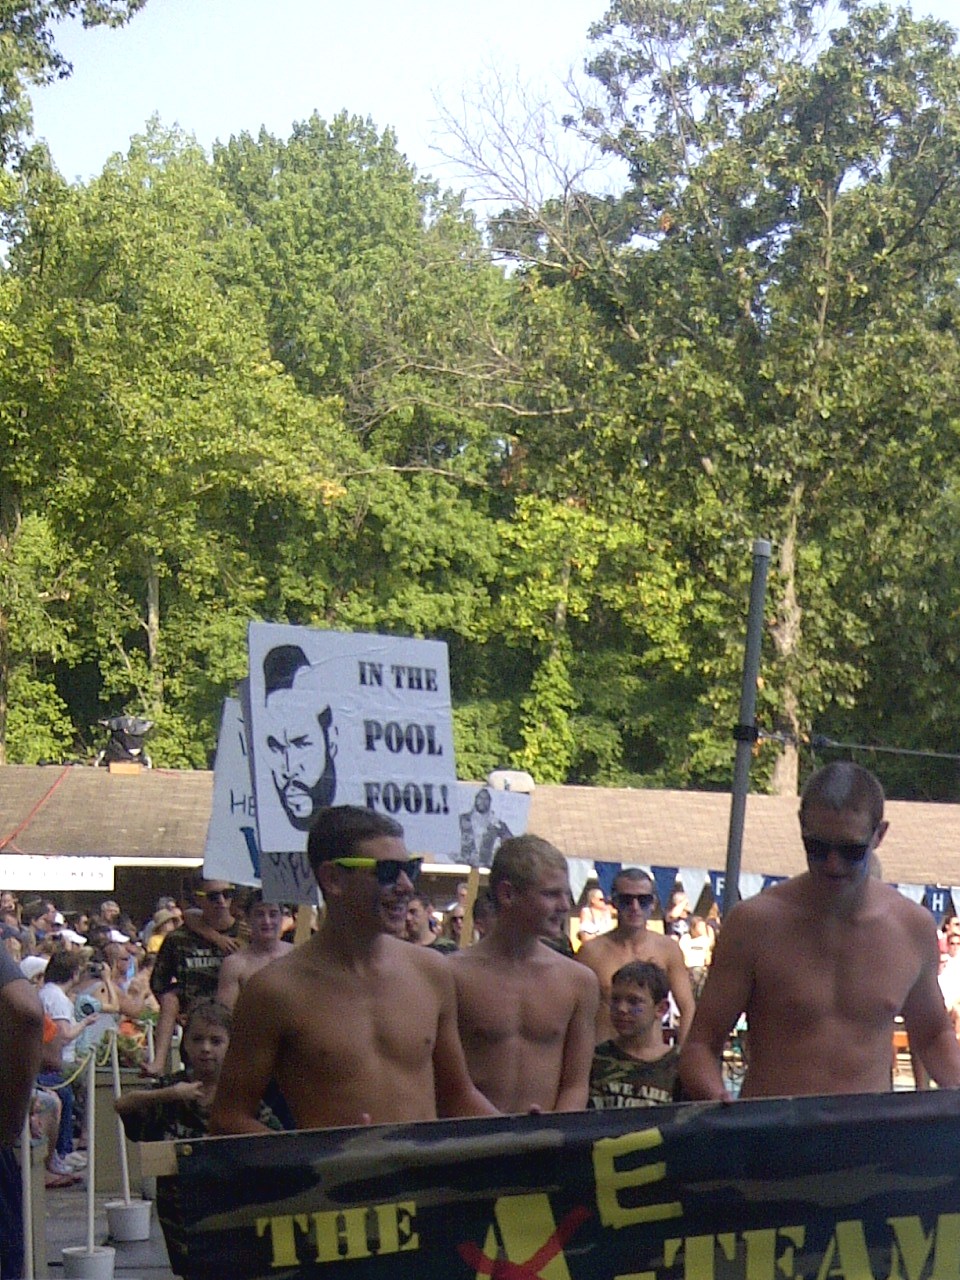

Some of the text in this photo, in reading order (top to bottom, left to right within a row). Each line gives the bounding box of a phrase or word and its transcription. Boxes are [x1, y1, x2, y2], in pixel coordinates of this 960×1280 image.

[358, 660, 439, 692] IN THE
[363, 718, 443, 756] POOL
[364, 781, 450, 816] FOOL!
[592, 1127, 684, 1230] E
[256, 1200, 420, 1268] THE
